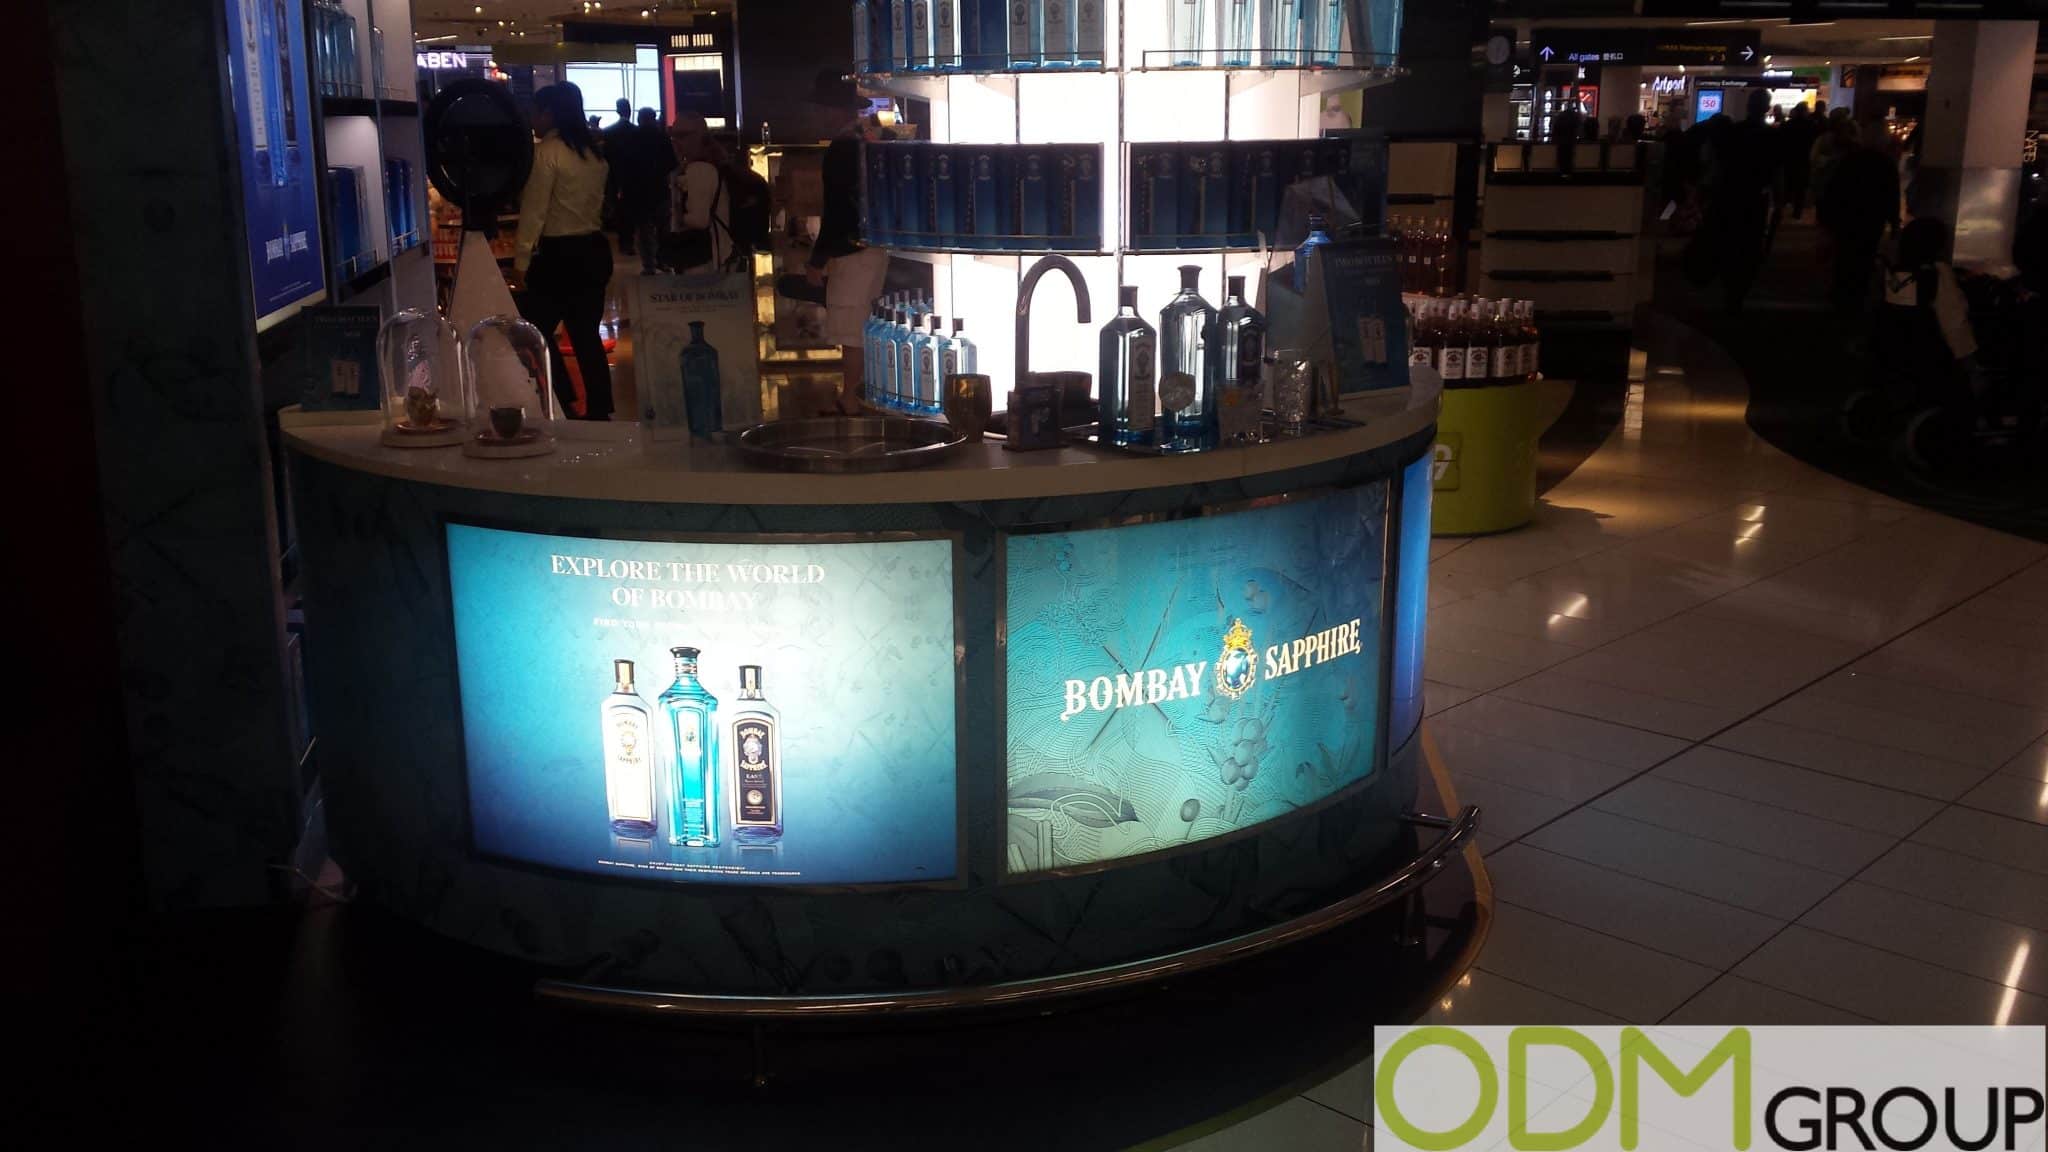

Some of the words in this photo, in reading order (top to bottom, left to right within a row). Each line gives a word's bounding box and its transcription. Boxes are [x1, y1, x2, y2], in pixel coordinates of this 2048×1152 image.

[1579, 53, 1600, 63] gates
[551, 554, 662, 580] EXPLORE
[667, 562, 720, 583] THE
[727, 563, 826, 584] WORLD
[612, 587, 643, 606] OF
[650, 588, 758, 611] BOMBAY
[1060, 660, 1208, 722] BOMBAY
[1264, 618, 1362, 681] SAPPHIRE
